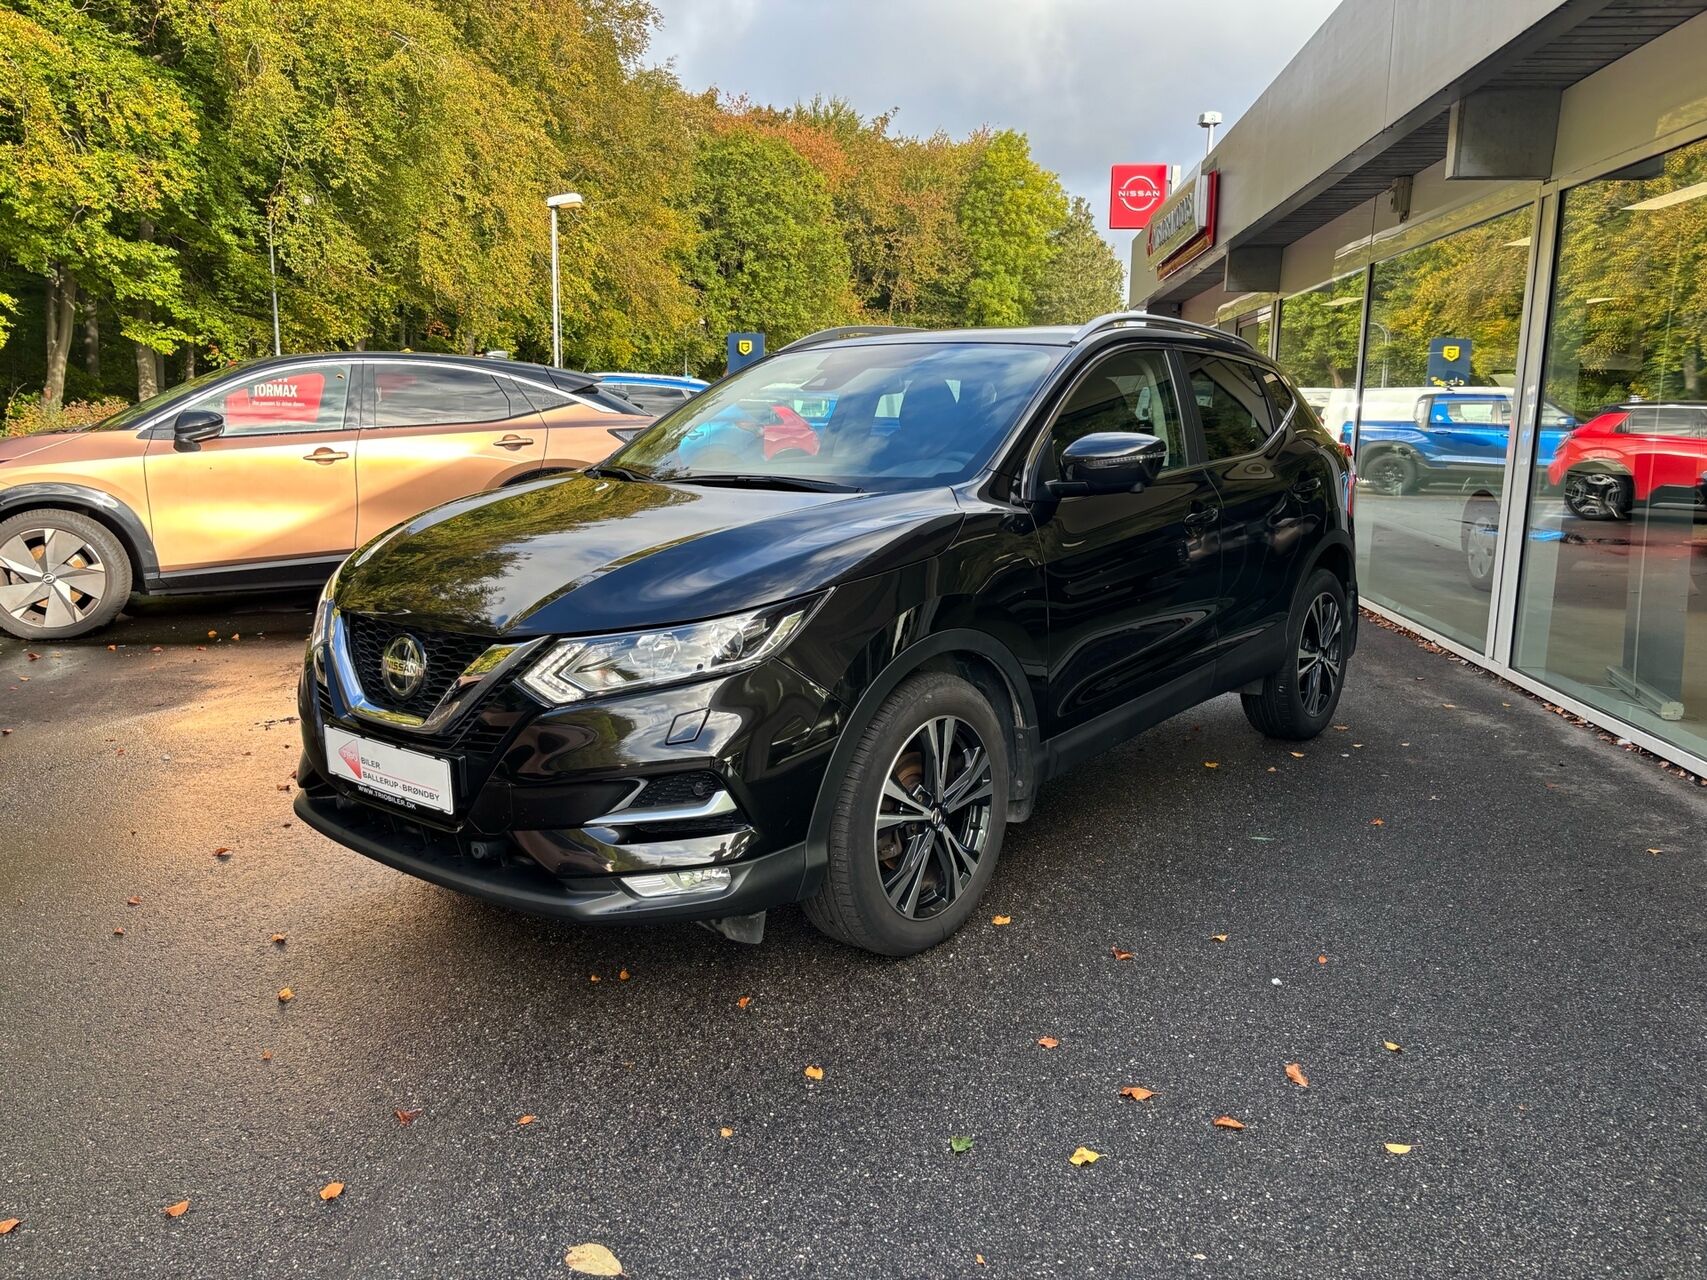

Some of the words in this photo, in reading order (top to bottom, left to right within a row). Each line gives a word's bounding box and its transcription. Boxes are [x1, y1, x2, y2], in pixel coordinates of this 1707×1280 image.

[254, 384, 298, 398] TORMAX
[386, 659, 416, 674] NISSAN
[361, 757, 381, 769] BILER
[357, 785, 417, 809] WWW.TRIOBILER.DK
